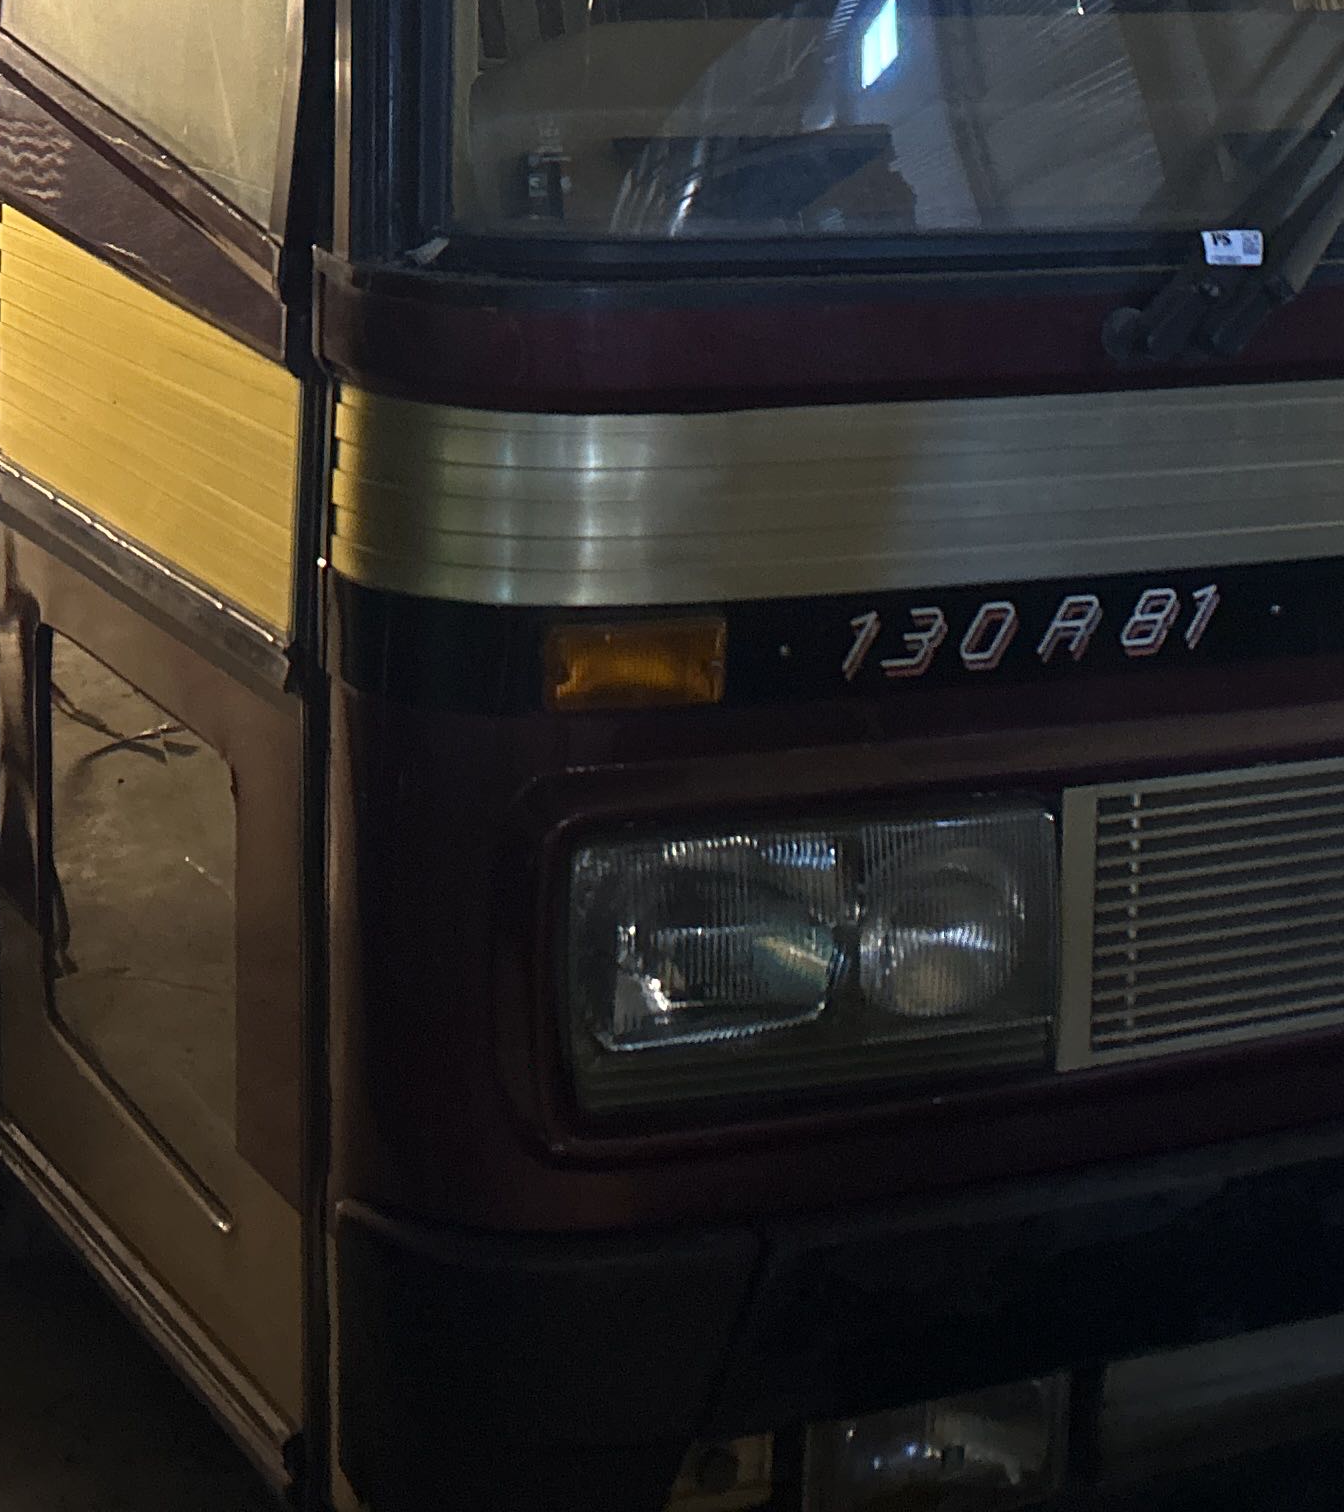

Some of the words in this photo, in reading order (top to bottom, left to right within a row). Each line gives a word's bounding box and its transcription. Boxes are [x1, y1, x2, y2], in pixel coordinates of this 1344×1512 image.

[842, 600, 1020, 682] 130
[1036, 593, 1104, 664] A
[1120, 582, 1222, 658] 81
